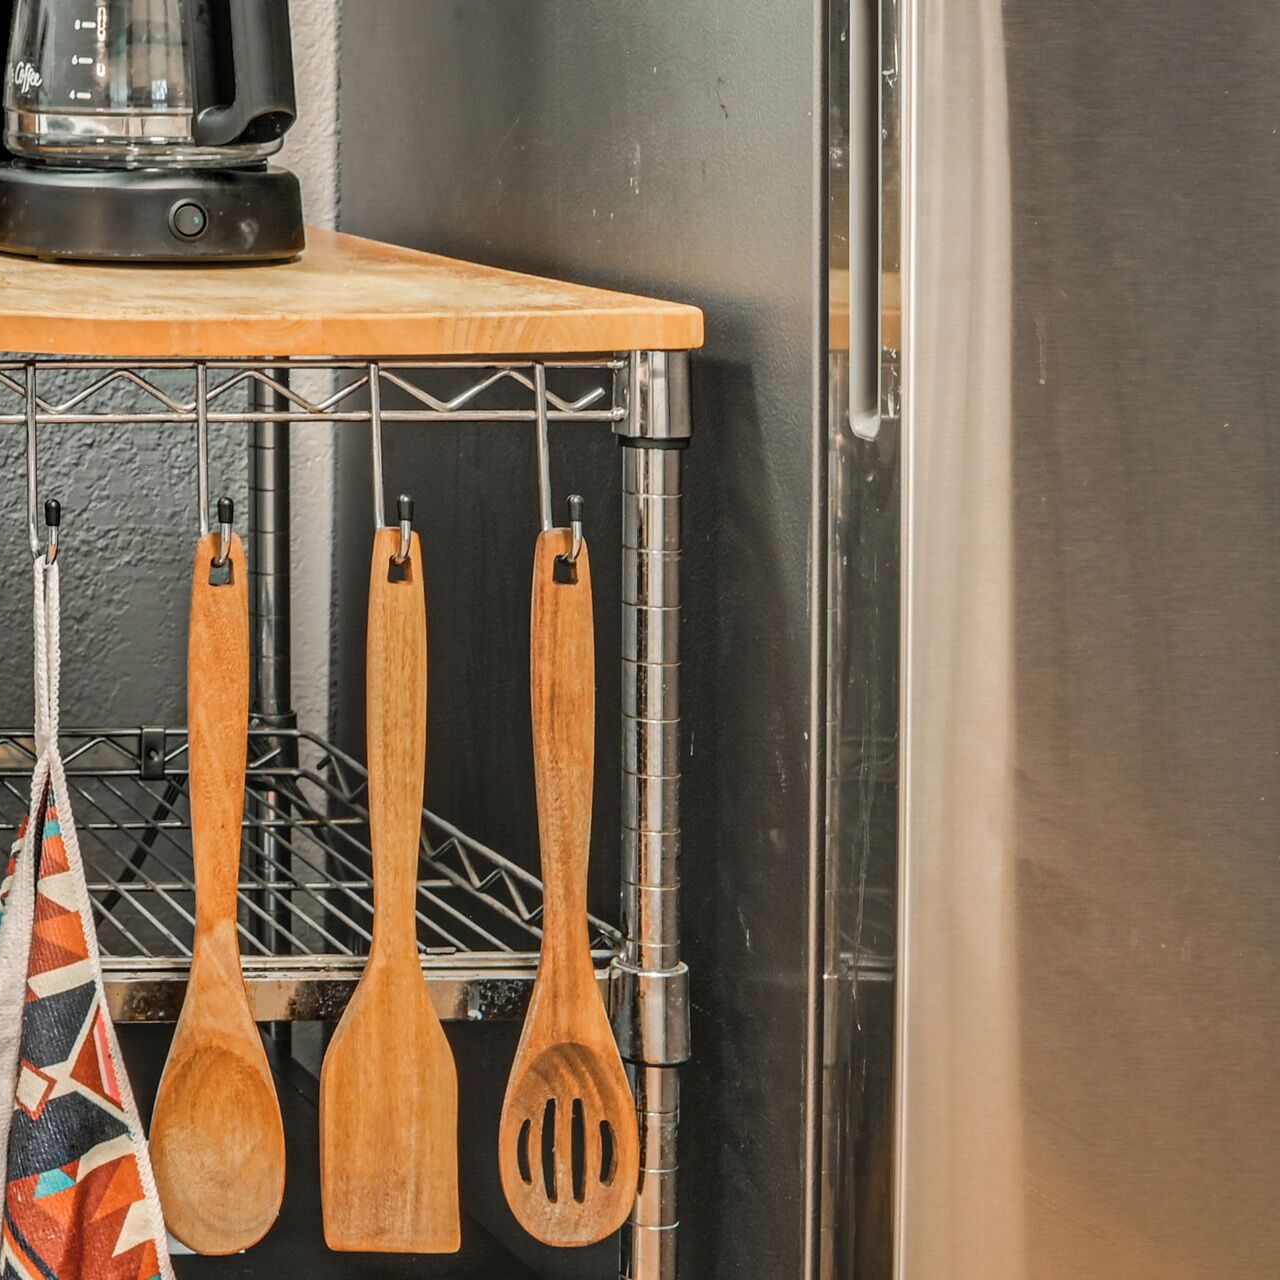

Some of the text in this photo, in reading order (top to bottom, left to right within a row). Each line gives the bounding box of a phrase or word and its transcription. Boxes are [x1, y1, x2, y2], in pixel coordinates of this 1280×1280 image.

[75, 19, 81, 30] 8
[72, 55, 78, 65] 6
[14, 61, 43, 93] Coffee
[69, 90, 76, 100] 4
